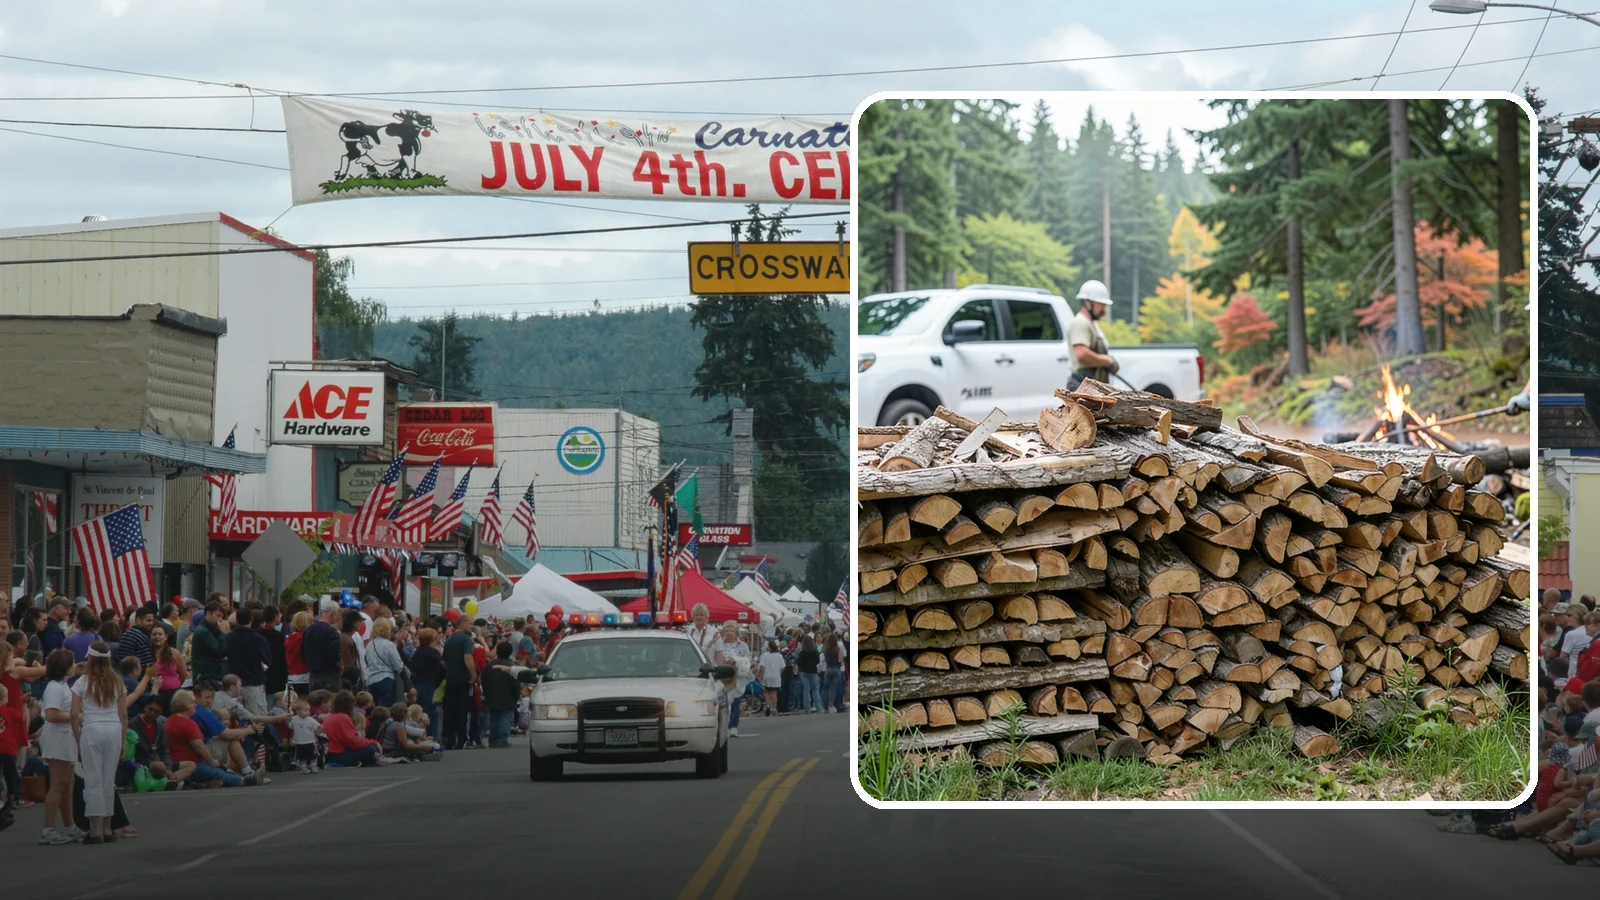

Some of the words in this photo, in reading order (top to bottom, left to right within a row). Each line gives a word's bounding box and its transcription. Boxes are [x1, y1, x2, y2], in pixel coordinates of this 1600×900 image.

[481, 141, 605, 193] JULY
[632, 150, 746, 198] 4th.
[697, 254, 850, 280] CROSSWA
[282, 379, 373, 420] ACE
[405, 409, 452, 422] CEDAR
[283, 420, 371, 437] Hardware
[416, 428, 477, 447] Coca-Cola
[353, 467, 386, 479] Simpl
[95, 485, 124, 494] Vincent
[126, 486, 136, 494] de
[137, 486, 155, 495] Paul
[212, 516, 331, 536] HARDARE
[688, 526, 742, 535] CRNATION
[699, 535, 730, 543] GLASS
